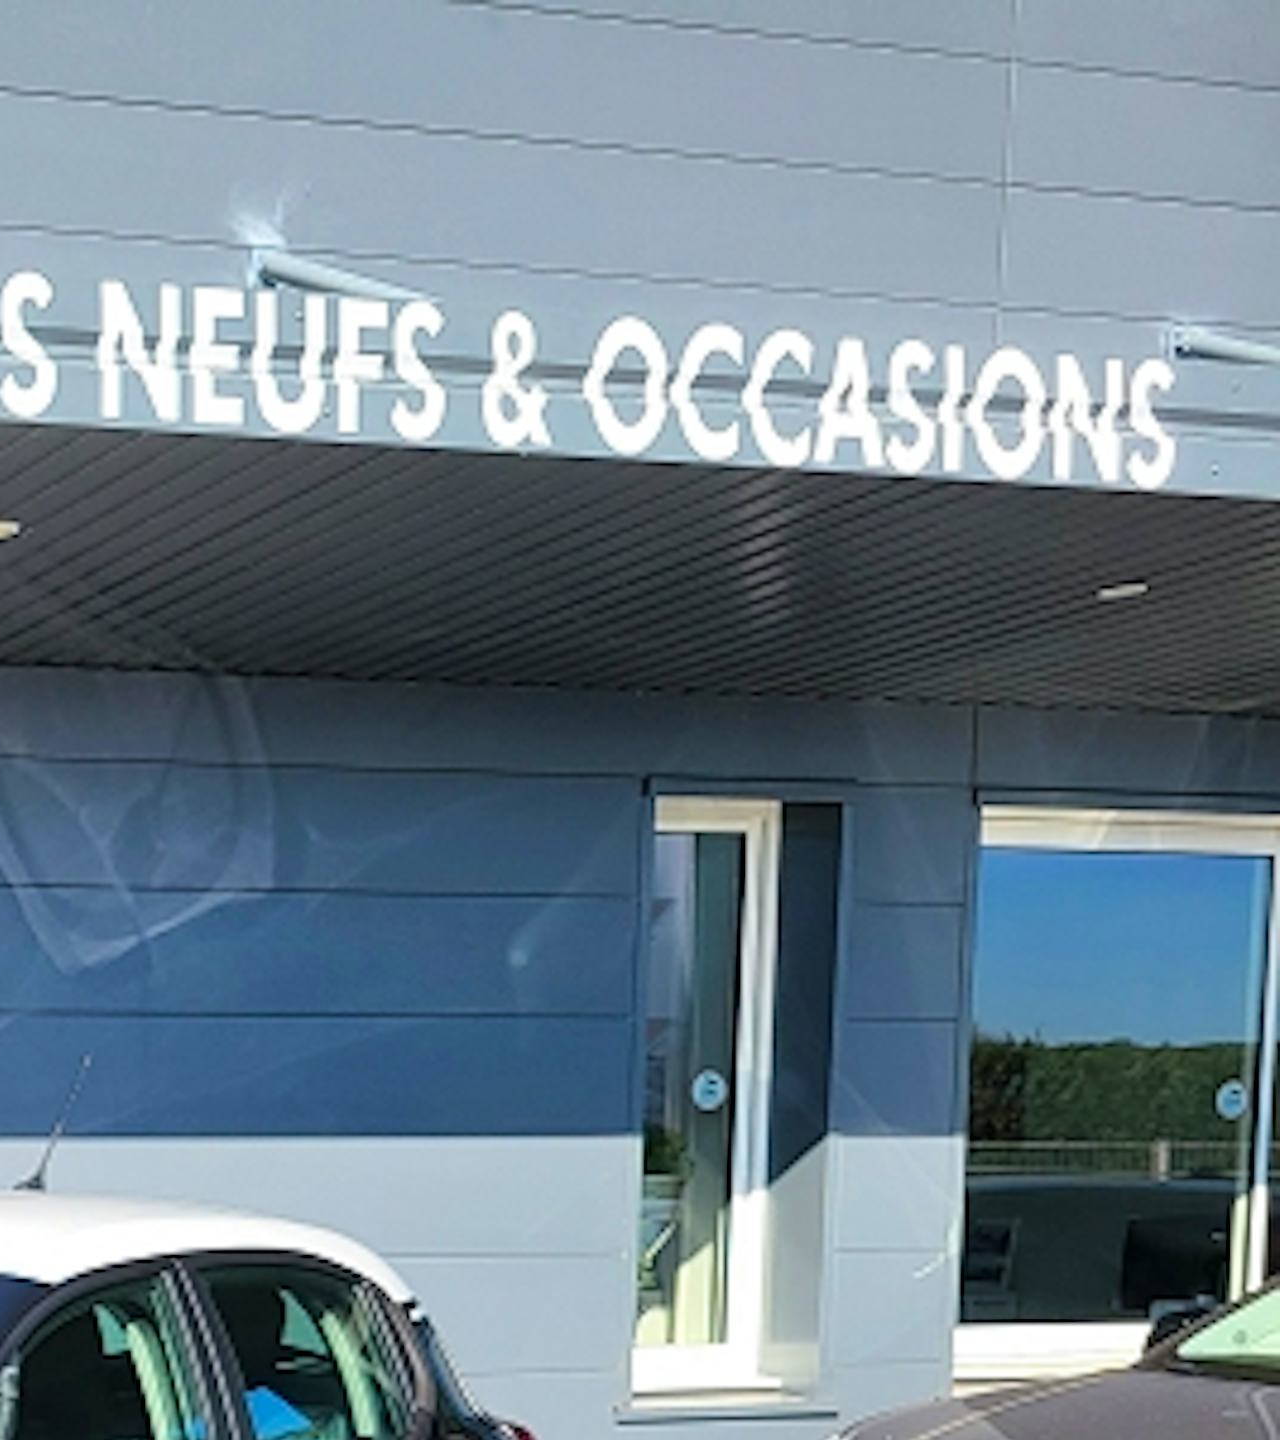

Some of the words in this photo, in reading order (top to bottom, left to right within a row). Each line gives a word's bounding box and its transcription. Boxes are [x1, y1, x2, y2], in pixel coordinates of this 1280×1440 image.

[96, 278, 444, 442] NEUFS
[482, 310, 552, 450] &
[583, 316, 1177, 491] OCCASIONS
